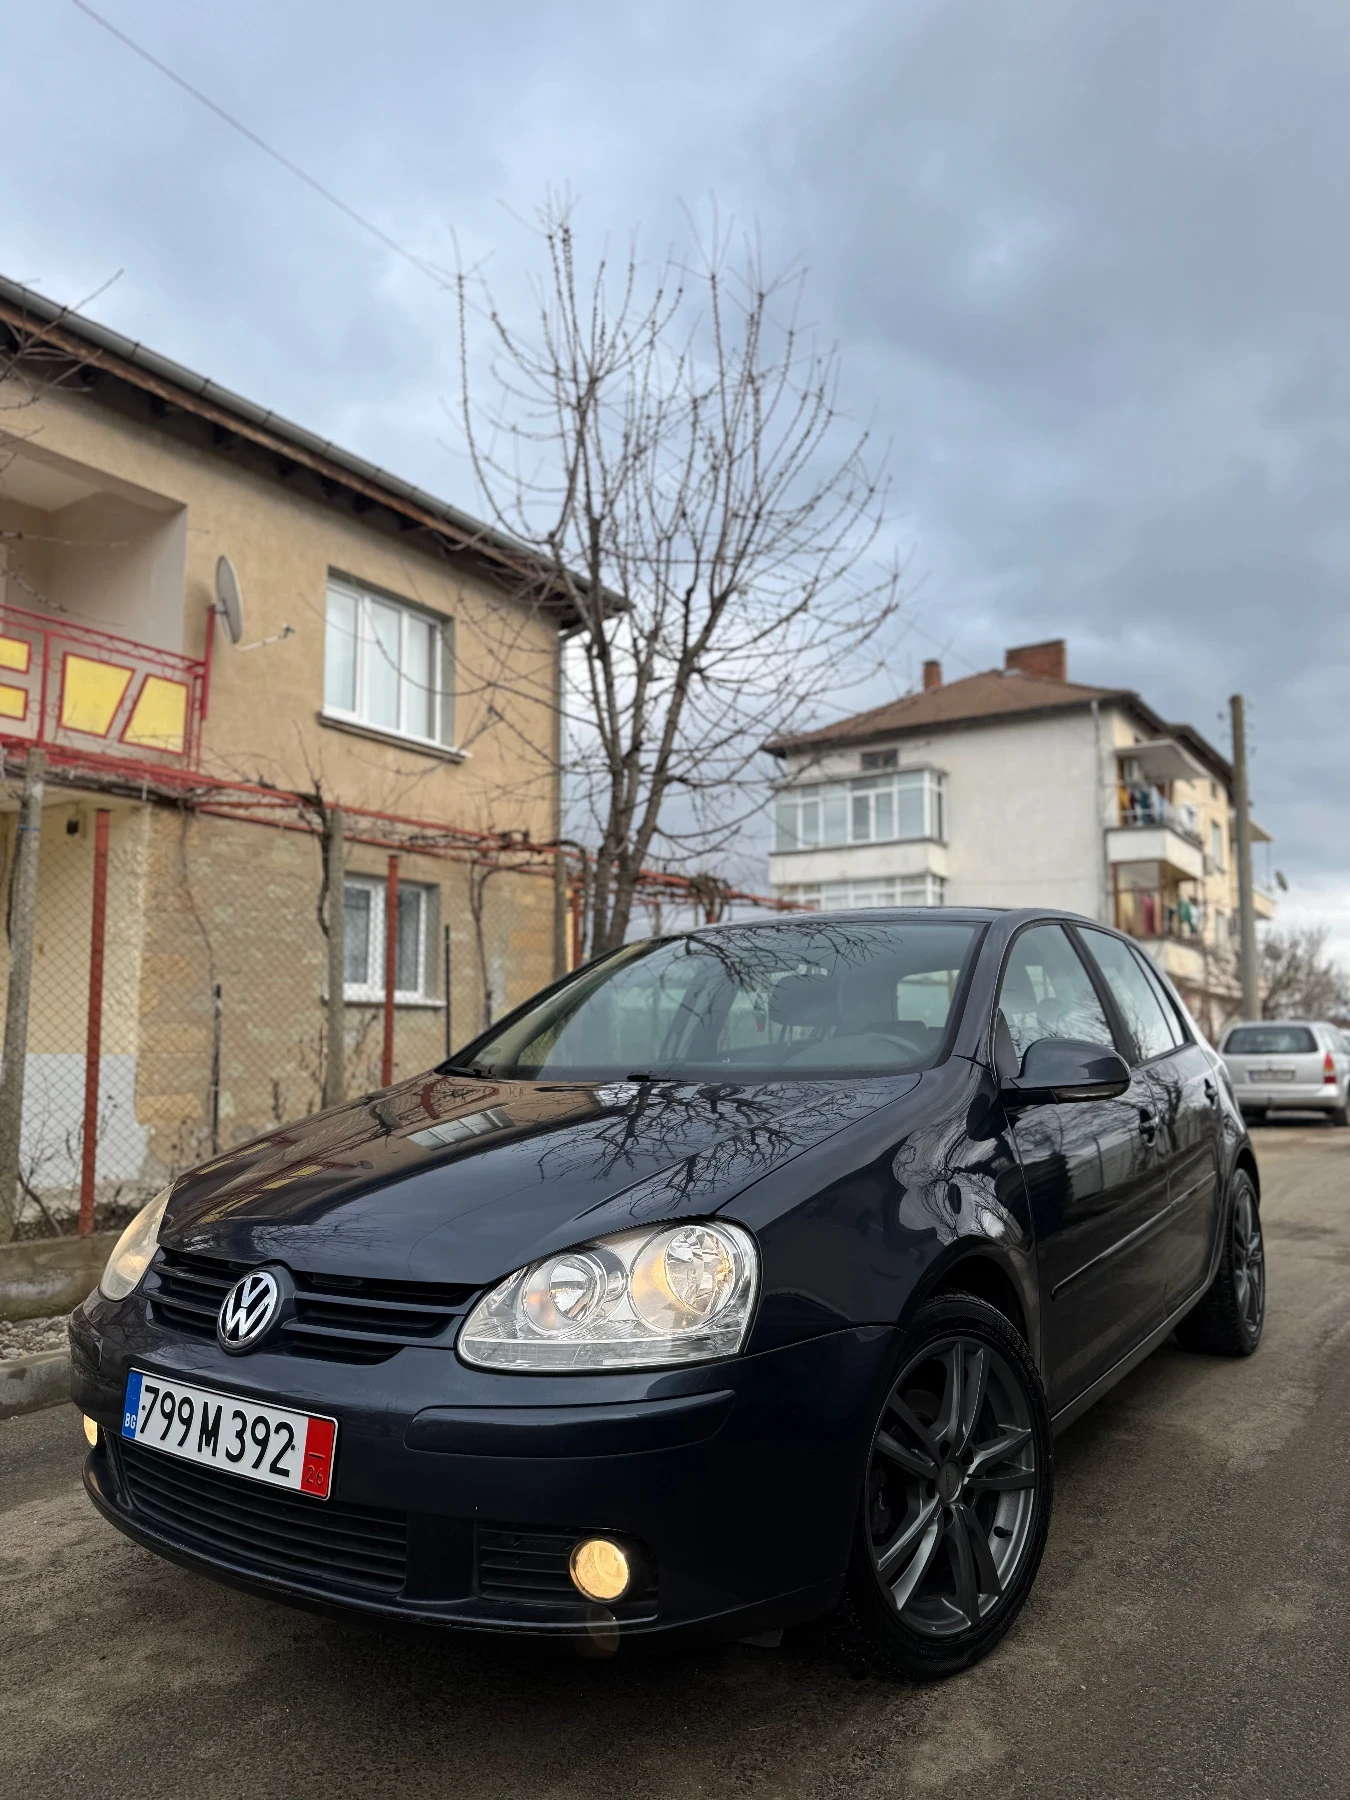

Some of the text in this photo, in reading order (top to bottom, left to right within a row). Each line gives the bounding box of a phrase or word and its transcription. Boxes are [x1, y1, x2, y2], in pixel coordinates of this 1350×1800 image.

[220, 1272, 278, 1344] VW
[124, 1412, 137, 1429] BG
[306, 1465, 325, 1486] 26
